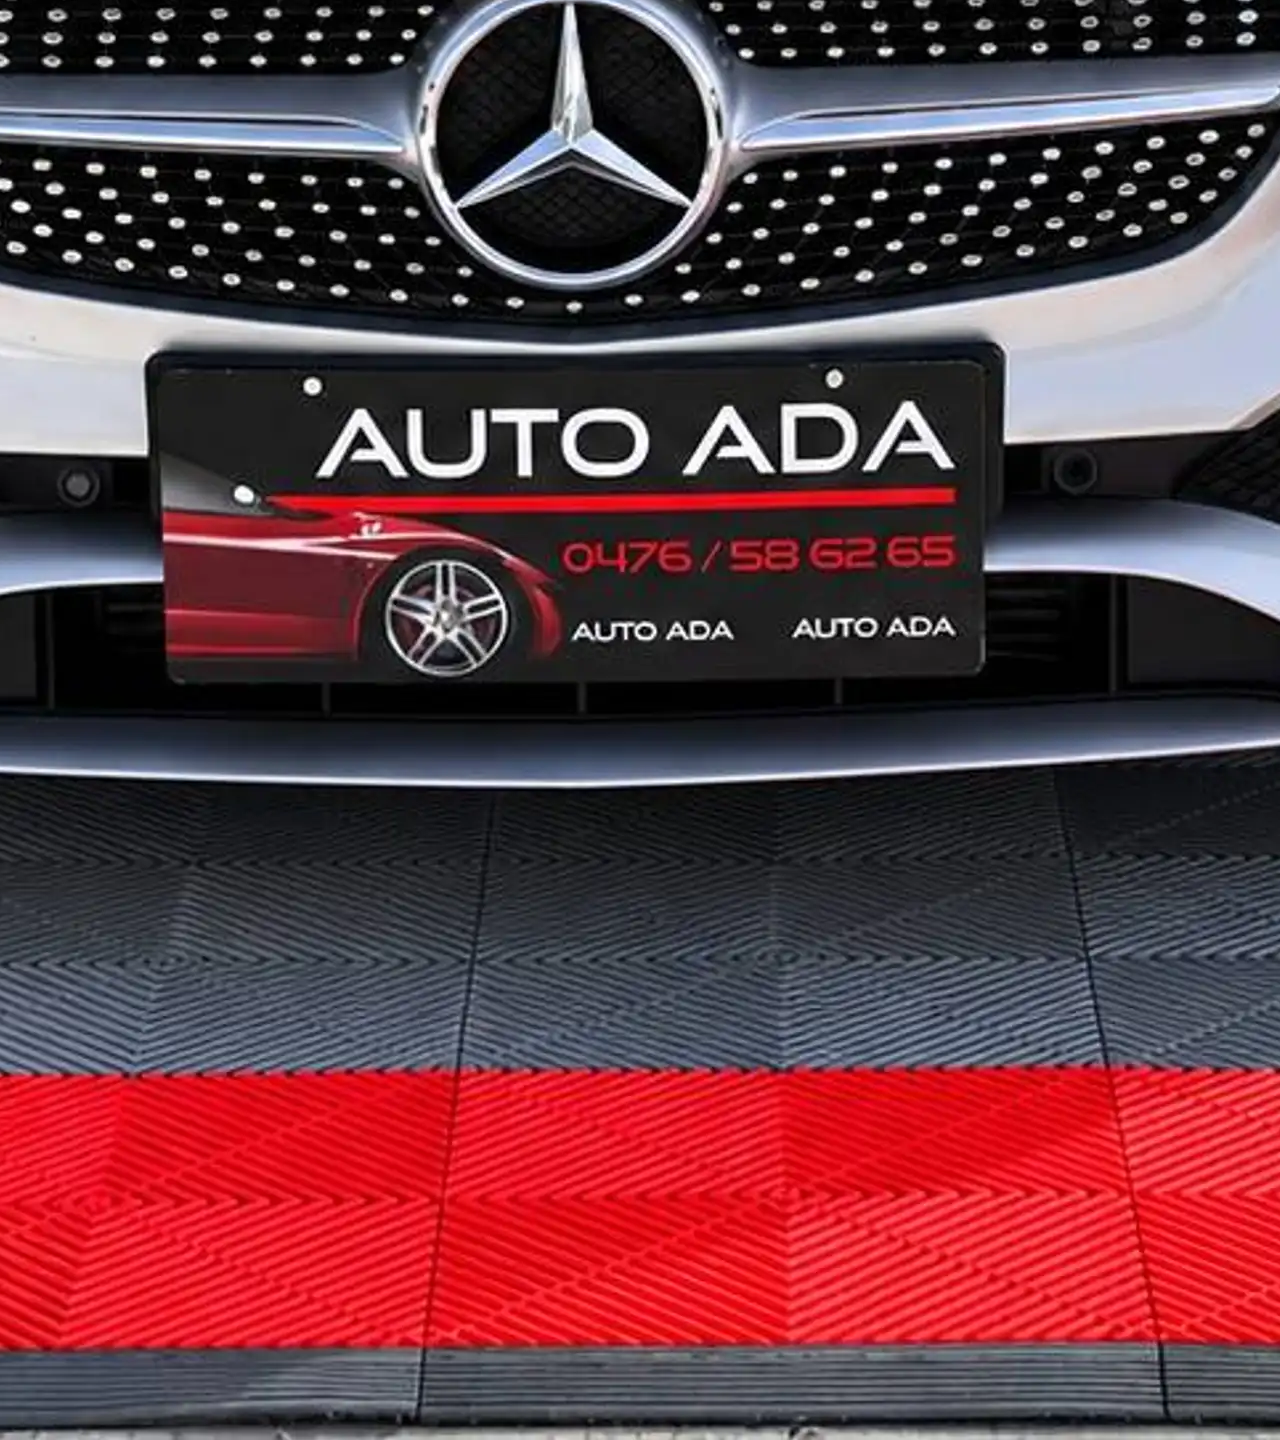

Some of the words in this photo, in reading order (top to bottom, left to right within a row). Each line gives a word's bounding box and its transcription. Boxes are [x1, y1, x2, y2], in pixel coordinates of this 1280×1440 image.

[315, 407, 651, 480] AUTO
[680, 400, 956, 477] ADA
[562, 540, 692, 574] 0476
[728, 539, 800, 572] 58
[808, 536, 878, 569] 62
[886, 534, 957, 568] 65
[571, 620, 658, 642] AUTO
[665, 619, 734, 641] ADA
[792, 617, 878, 639] AUTO
[886, 615, 956, 638] ADA
